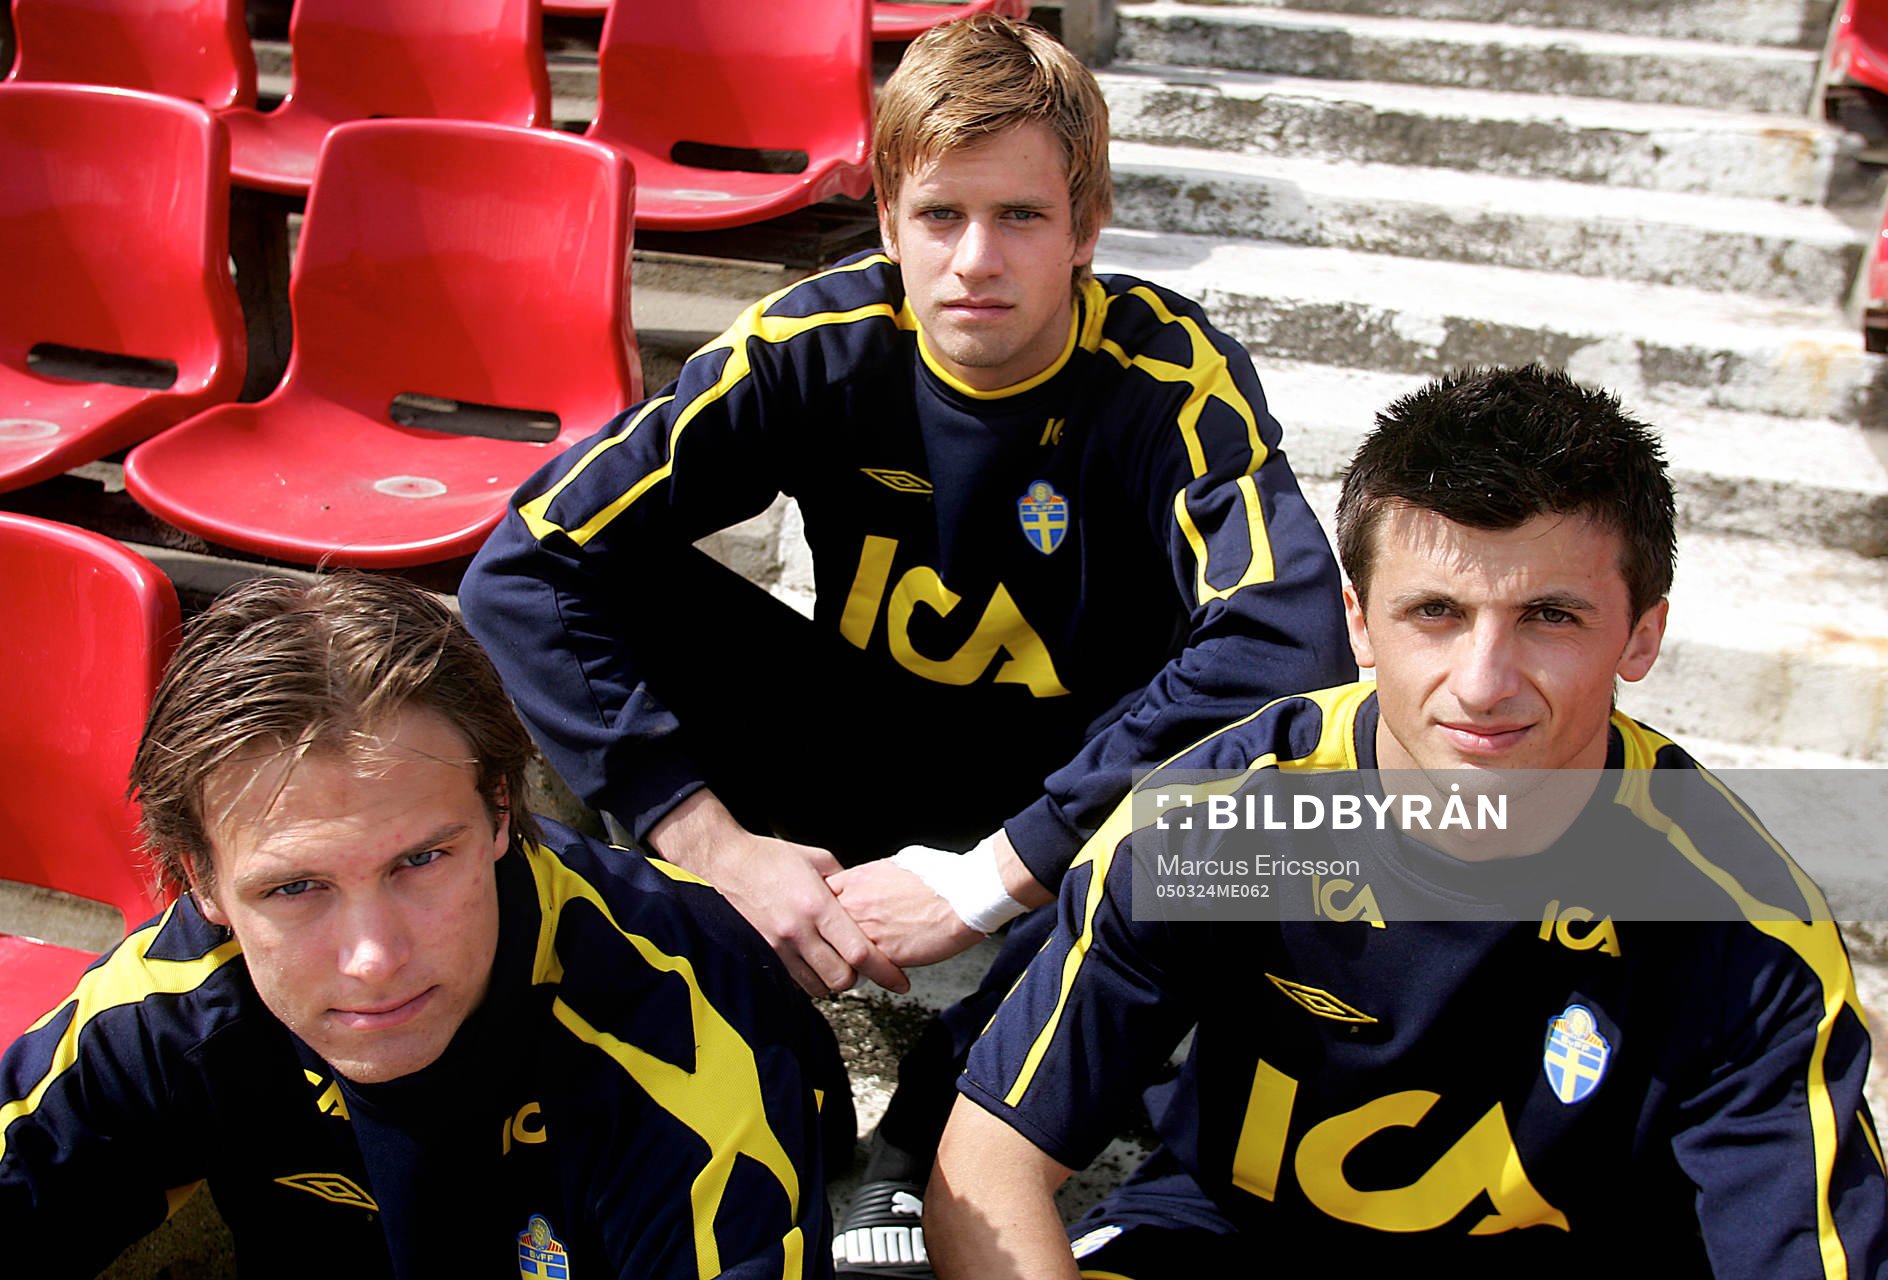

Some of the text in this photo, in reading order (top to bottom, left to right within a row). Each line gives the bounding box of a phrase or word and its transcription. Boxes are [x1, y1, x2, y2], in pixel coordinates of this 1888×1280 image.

[839, 535, 1071, 698] ICA
[1312, 874, 1387, 929] ICA
[1538, 900, 1622, 957] ICA
[1232, 1058, 1570, 1236] ICA
